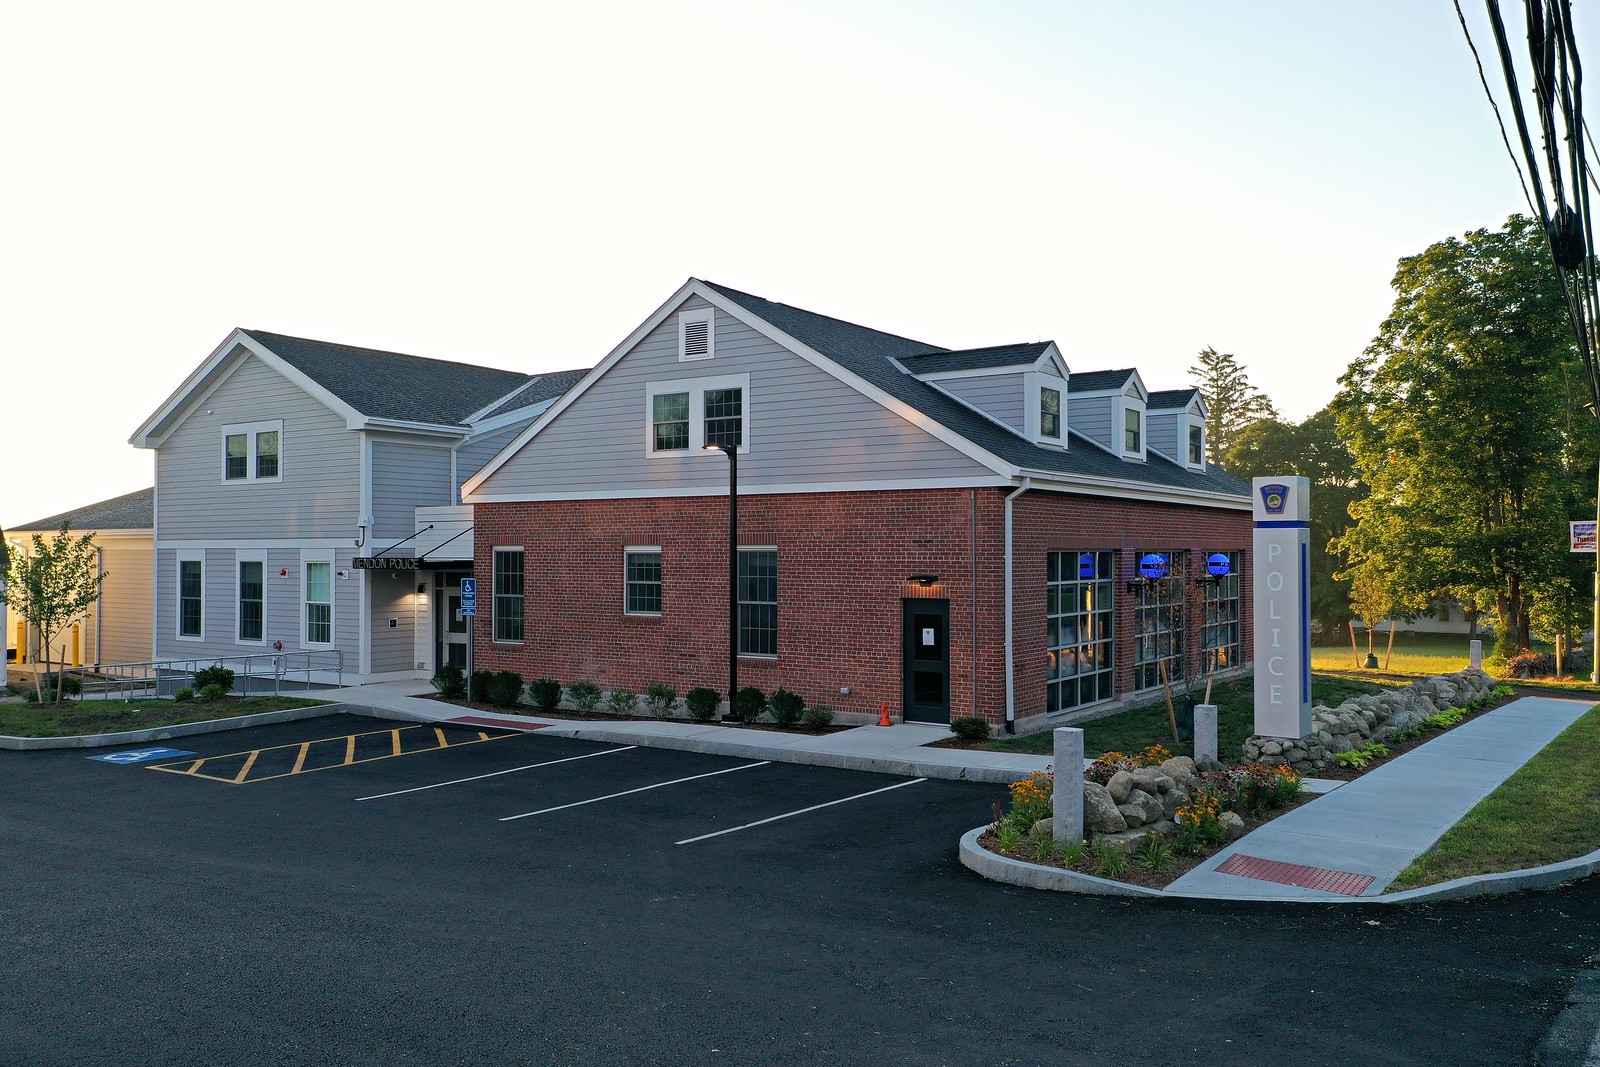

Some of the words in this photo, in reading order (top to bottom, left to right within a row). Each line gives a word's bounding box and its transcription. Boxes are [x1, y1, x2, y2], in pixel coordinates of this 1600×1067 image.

[353, 558, 387, 569] MENDON
[390, 558, 419, 569] POLICE
[1267, 544, 1284, 704] POLICE
